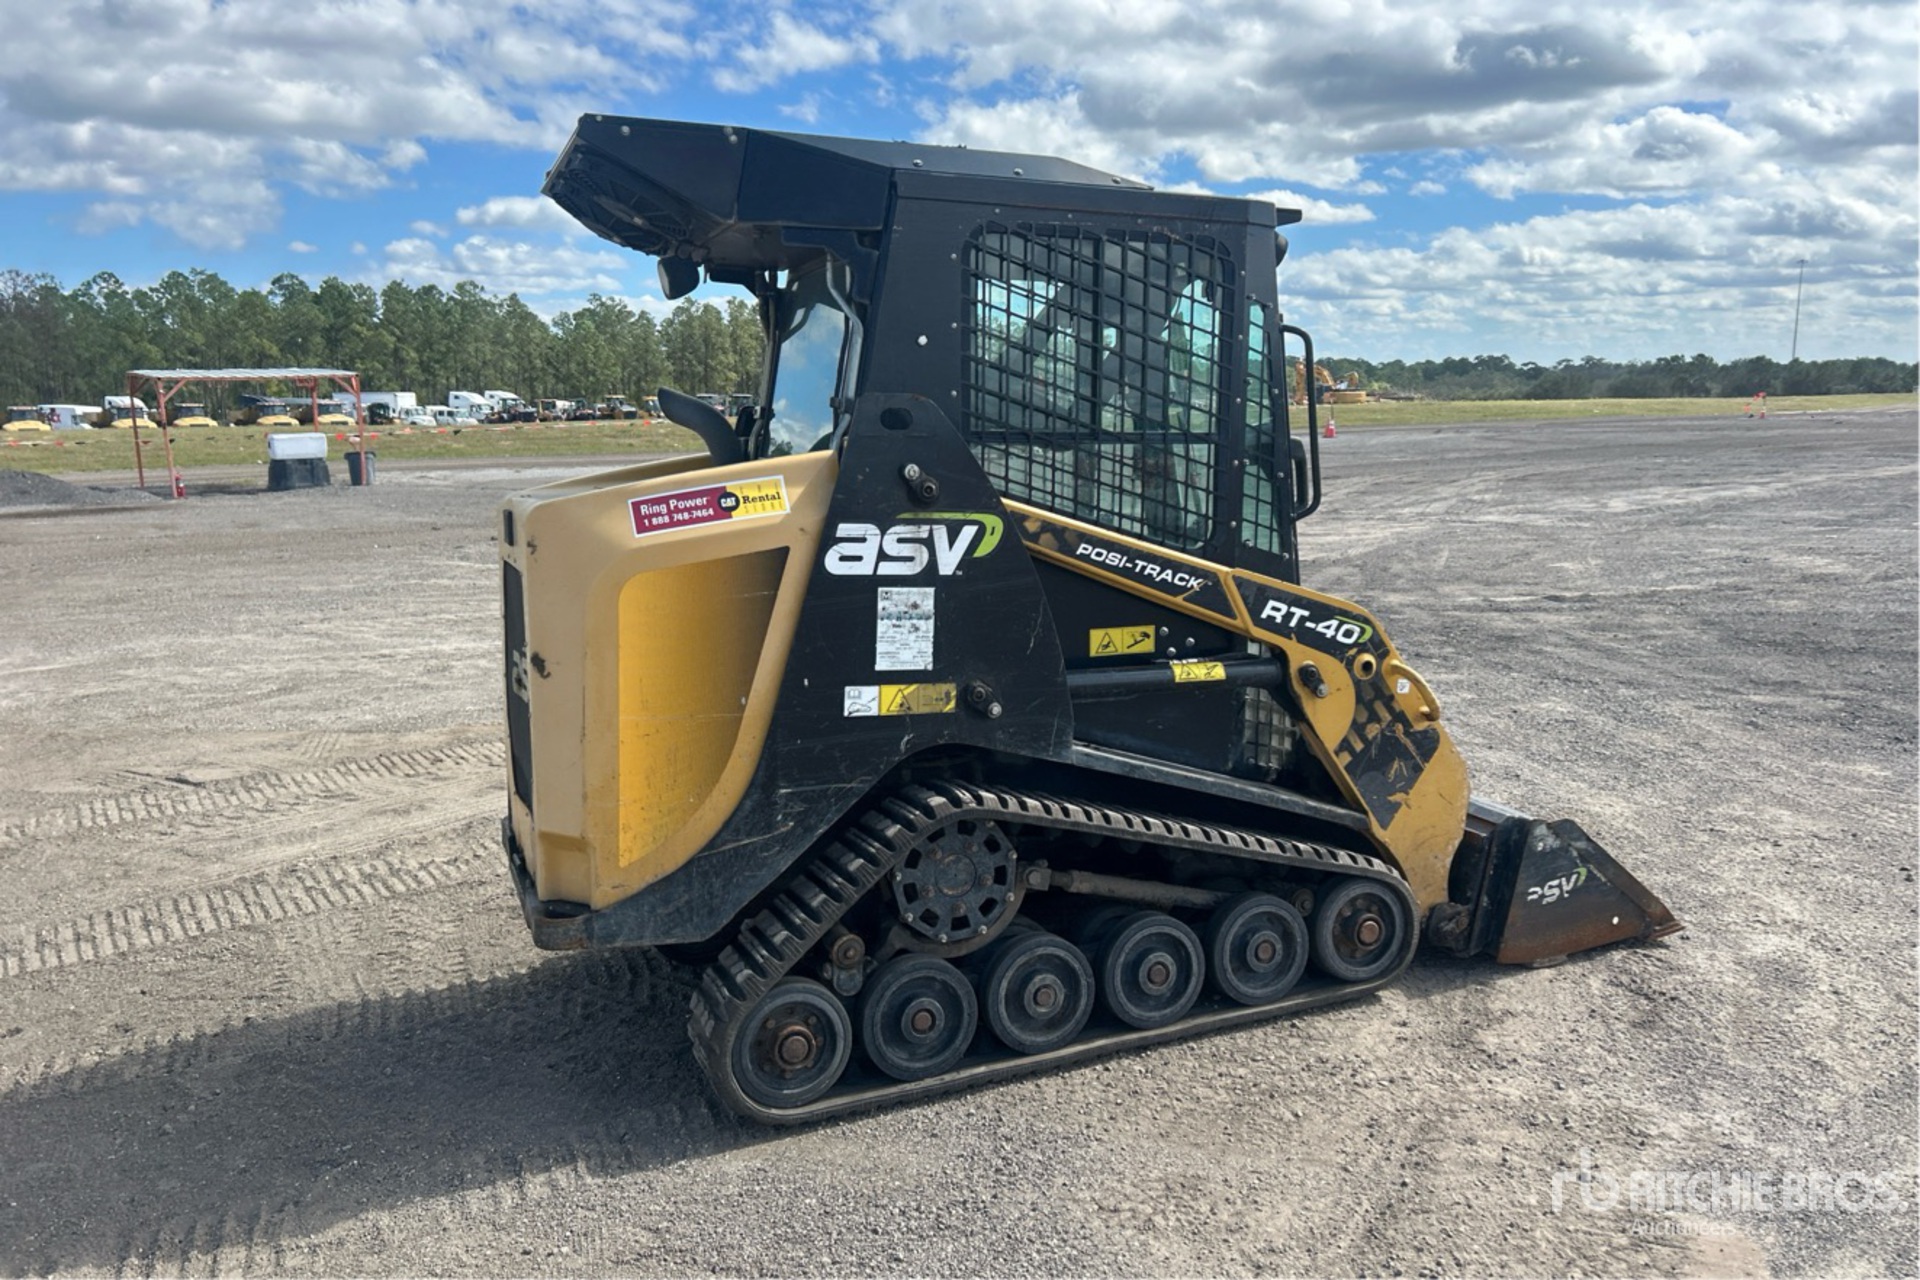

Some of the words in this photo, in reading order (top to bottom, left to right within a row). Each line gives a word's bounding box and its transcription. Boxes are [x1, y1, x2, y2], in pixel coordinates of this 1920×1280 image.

[640, 503, 667, 516] Ring
[669, 497, 708, 510] Power
[720, 497, 736, 507] CAT
[741, 491, 781, 504] Rental
[644, 519, 649, 527] 1
[651, 515, 670, 525] 888
[672, 508, 714, 522] 748-7464
[1076, 543, 1204, 591] POSI-TRACK
[1260, 599, 1361, 645] RT-40
